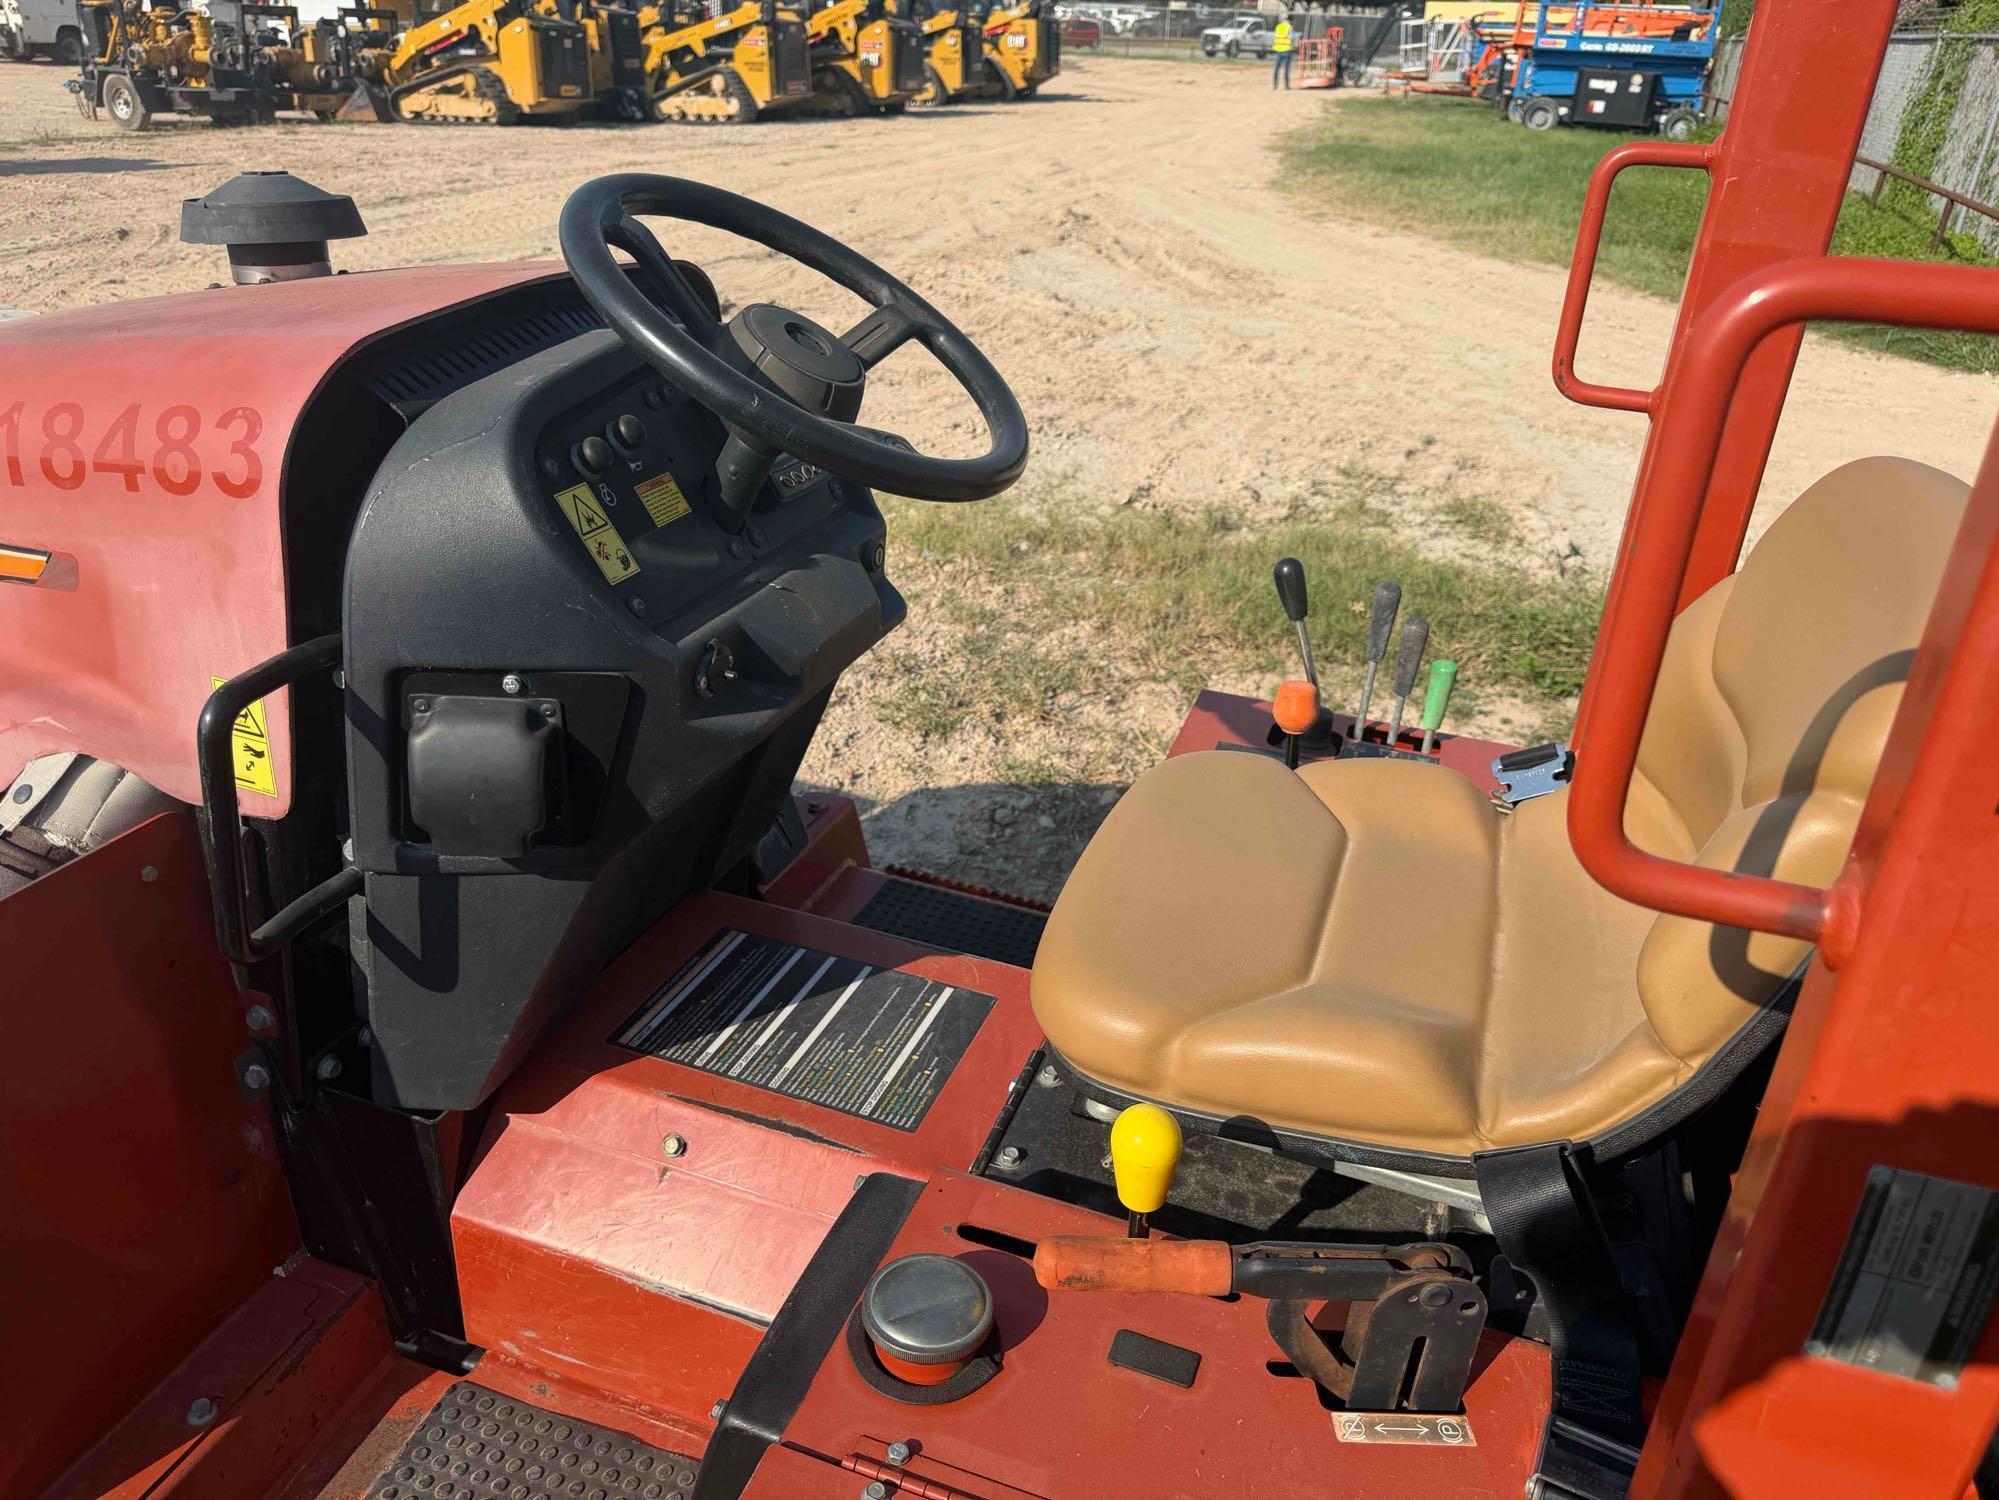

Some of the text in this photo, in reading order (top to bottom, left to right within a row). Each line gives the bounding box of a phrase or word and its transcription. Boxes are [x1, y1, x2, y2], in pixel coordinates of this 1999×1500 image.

[0, 403, 263, 499] 18483
[696, 1051, 712, 1065] DRIVE
[730, 1044, 761, 1075] STOP DRIVING
[770, 1066, 790, 1087] DIGGING
[861, 1079, 890, 1115] STOP DIGGING
